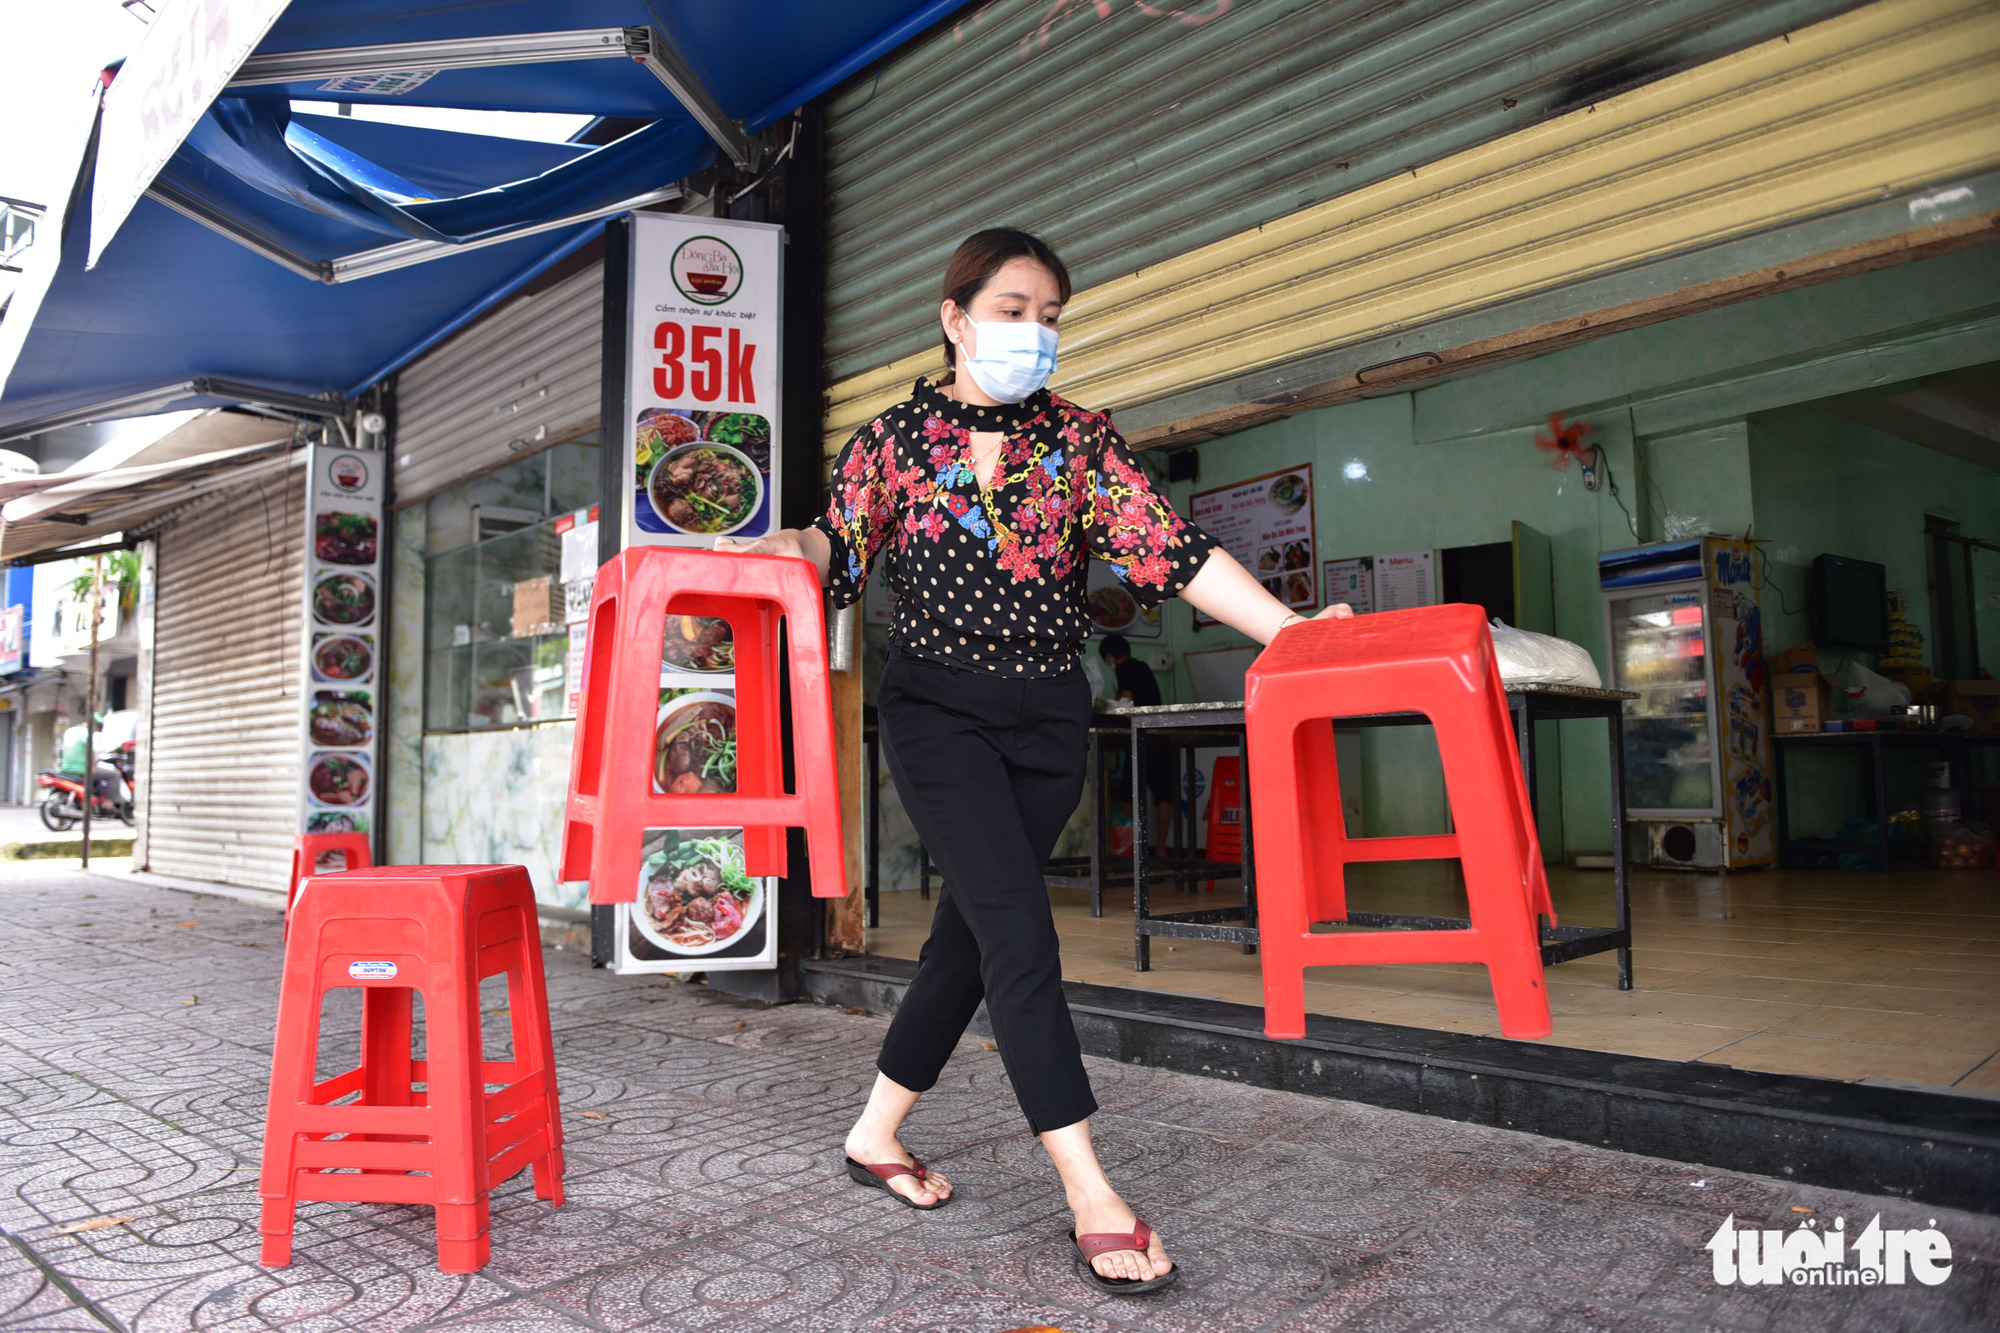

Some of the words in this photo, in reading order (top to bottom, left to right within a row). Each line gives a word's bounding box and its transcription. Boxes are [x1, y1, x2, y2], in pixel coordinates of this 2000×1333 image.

[713, 250, 727, 263] Ba
[655, 303, 676, 313] Cảm
[678, 306, 700, 316] nhận
[702, 308, 713, 318] sự
[715, 309, 737, 319] khác
[739, 311, 757, 320] biệt
[653, 321, 757, 404] 35k
[1388, 557, 1414, 566] Menu
